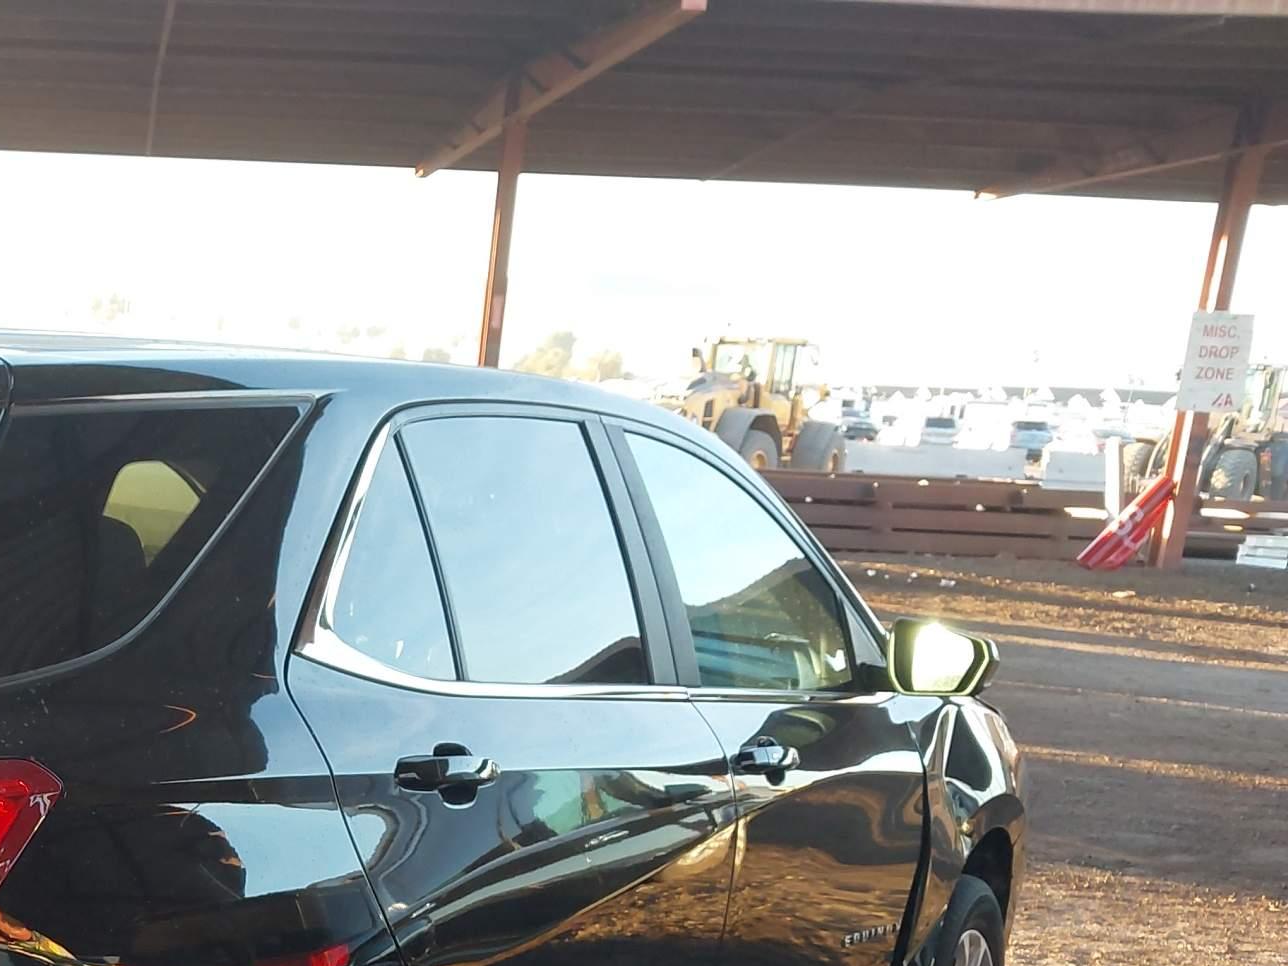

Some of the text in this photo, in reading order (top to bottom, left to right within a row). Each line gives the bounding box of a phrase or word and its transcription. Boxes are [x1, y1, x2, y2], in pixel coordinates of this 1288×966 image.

[1202, 323, 1241, 338] MISC.
[1198, 344, 1240, 359] DROP
[1195, 366, 1235, 380] ZONE
